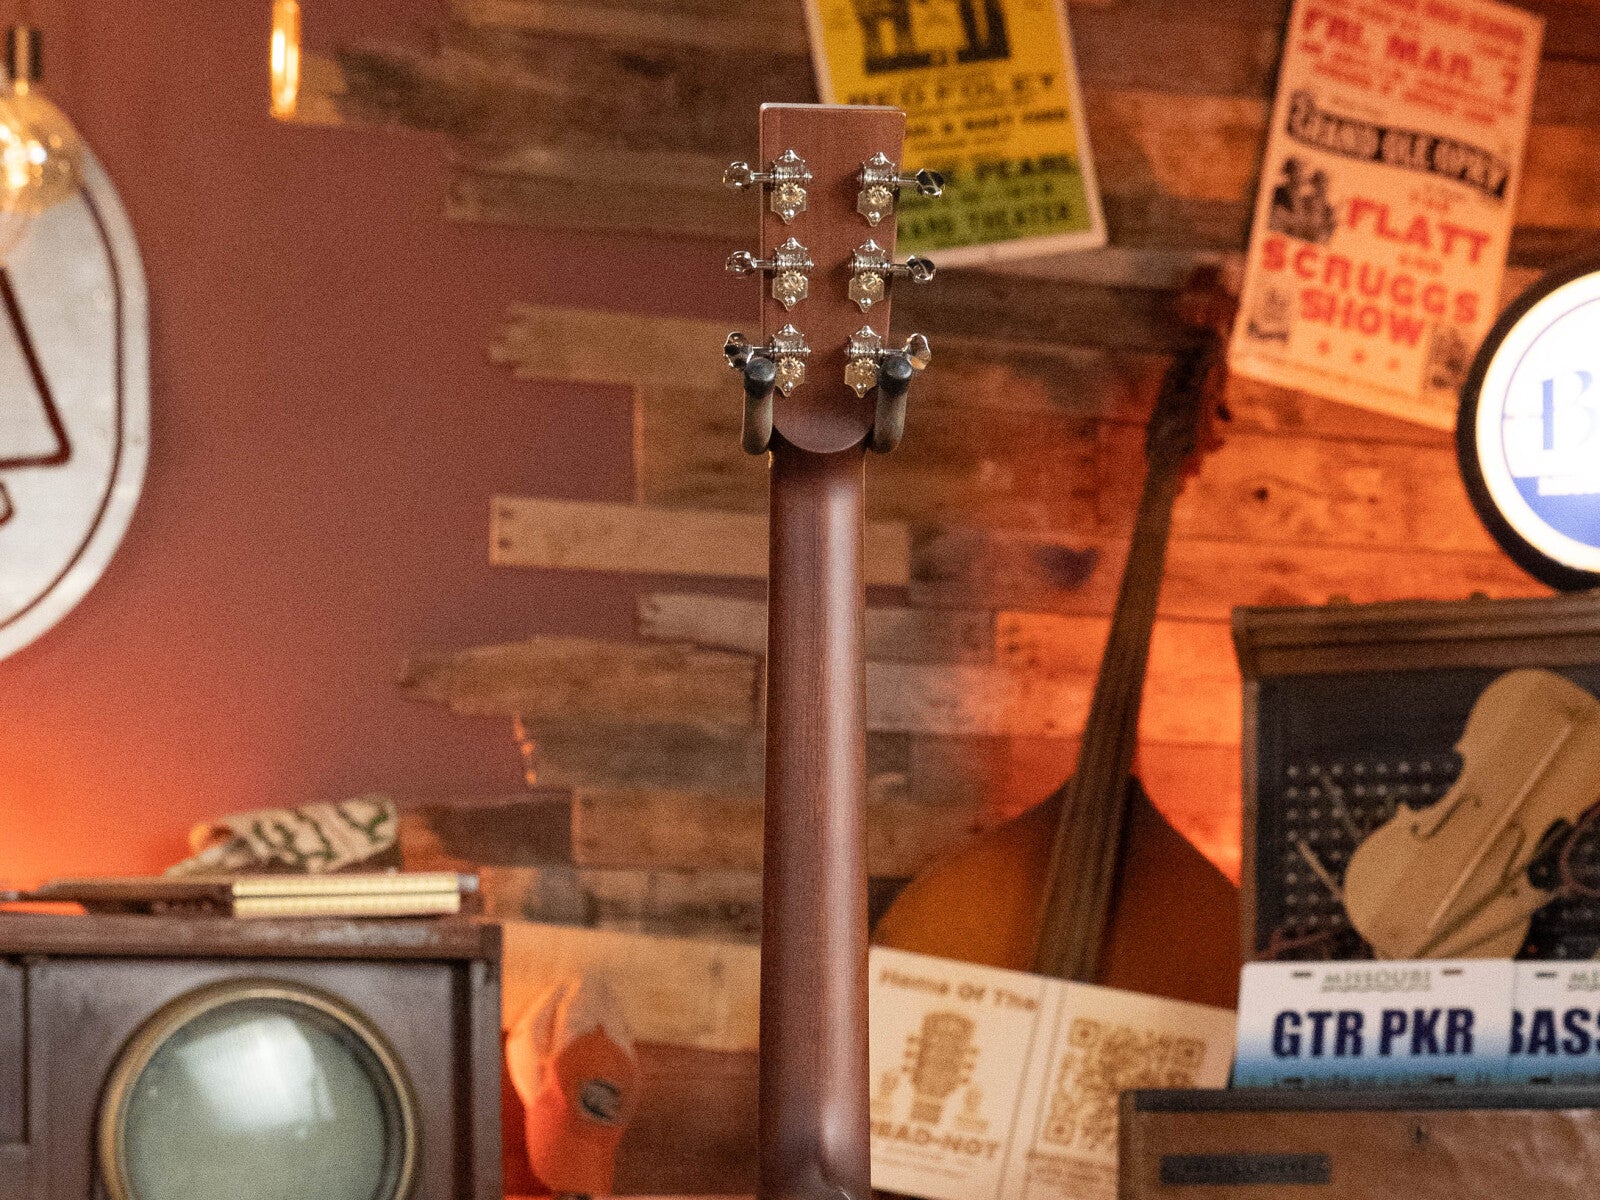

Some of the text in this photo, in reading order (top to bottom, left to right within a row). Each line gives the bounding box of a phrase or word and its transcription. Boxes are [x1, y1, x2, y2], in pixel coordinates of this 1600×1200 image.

[1347, 197, 1492, 265] FLATT
[1262, 234, 1479, 324] SCRUGGS
[1300, 288, 1426, 347] SHOW
[880, 969, 949, 995] Home
[1273, 1007, 1475, 1058] GTR PKR
